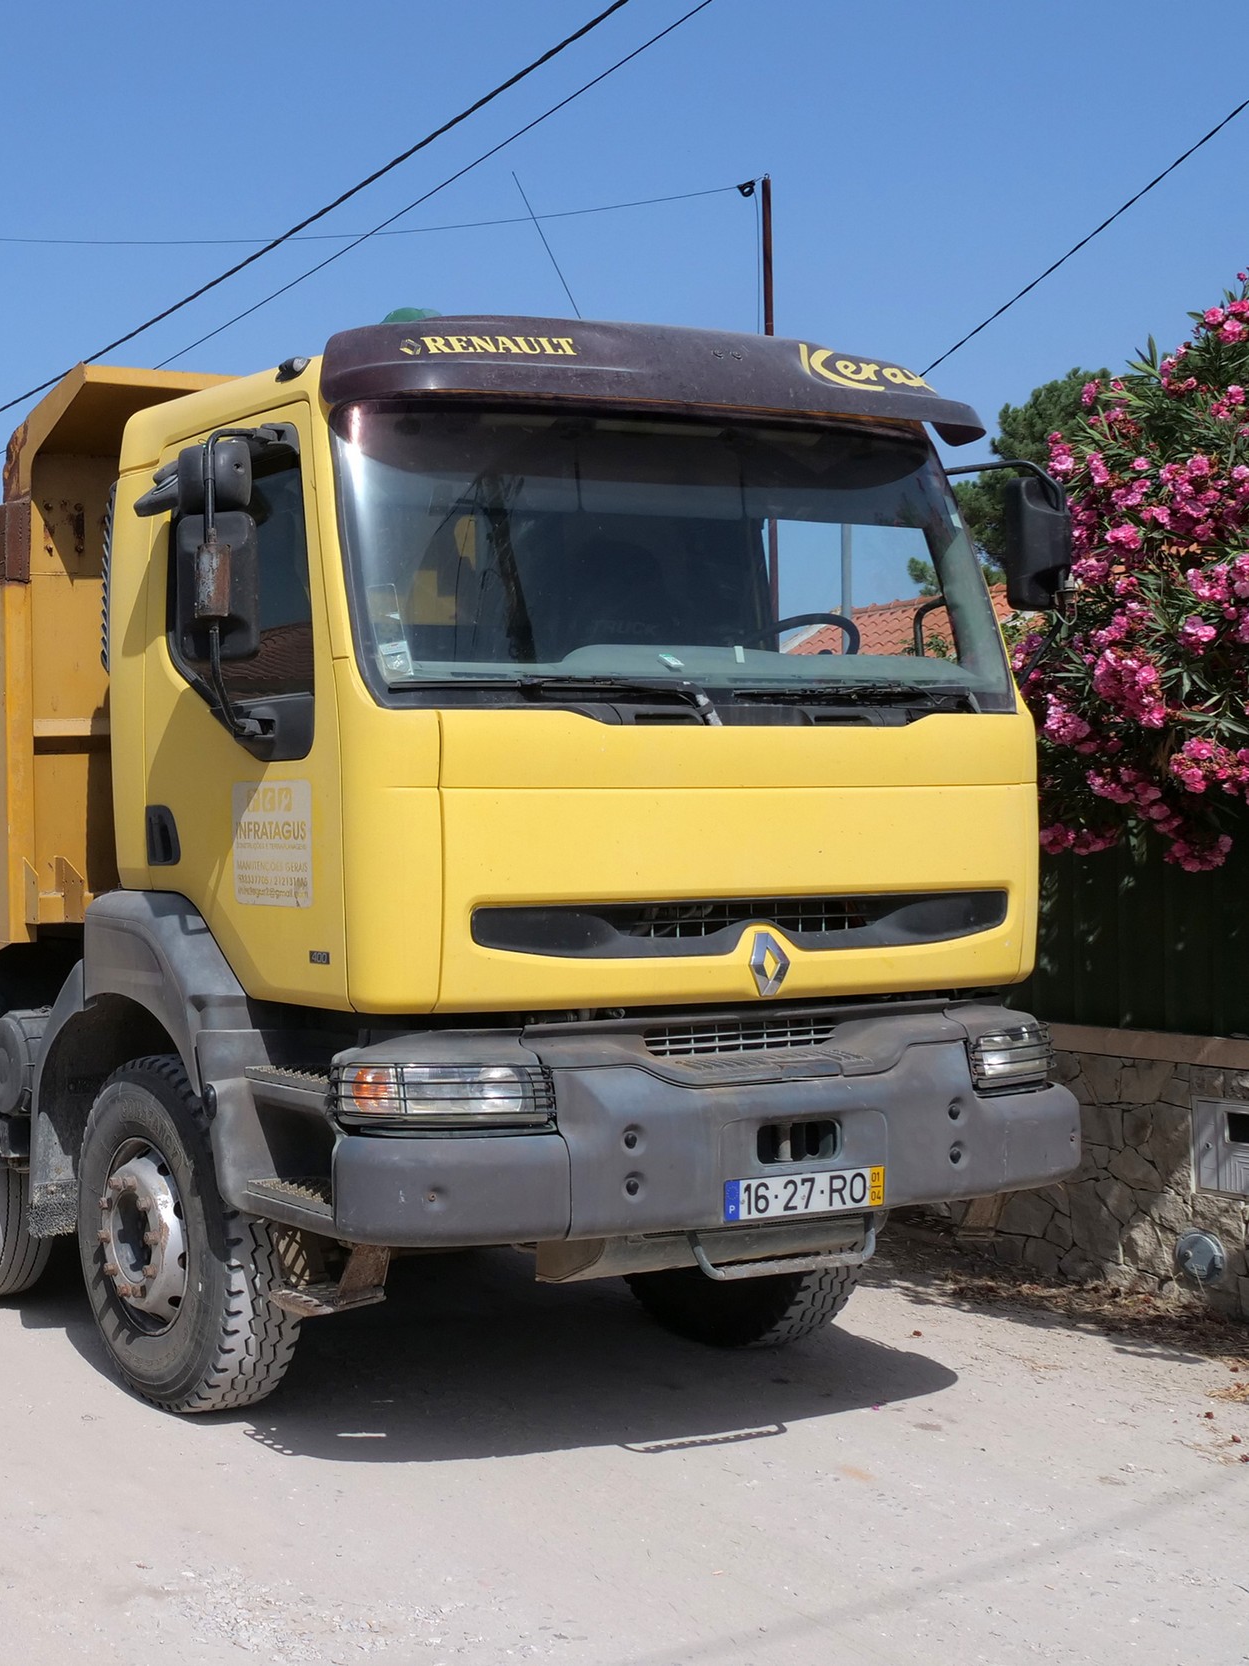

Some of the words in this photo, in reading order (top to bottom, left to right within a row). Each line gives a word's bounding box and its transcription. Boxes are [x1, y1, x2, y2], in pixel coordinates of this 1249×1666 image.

[420, 336, 577, 356] RENAULT
[236, 820, 306, 840] INFRATAGUS
[285, 862, 308, 873] GERAIS
[311, 952, 327, 963] 400
[871, 1172, 880, 1183] 01
[870, 1190, 881, 1201] 04
[729, 1205, 736, 1214] P
